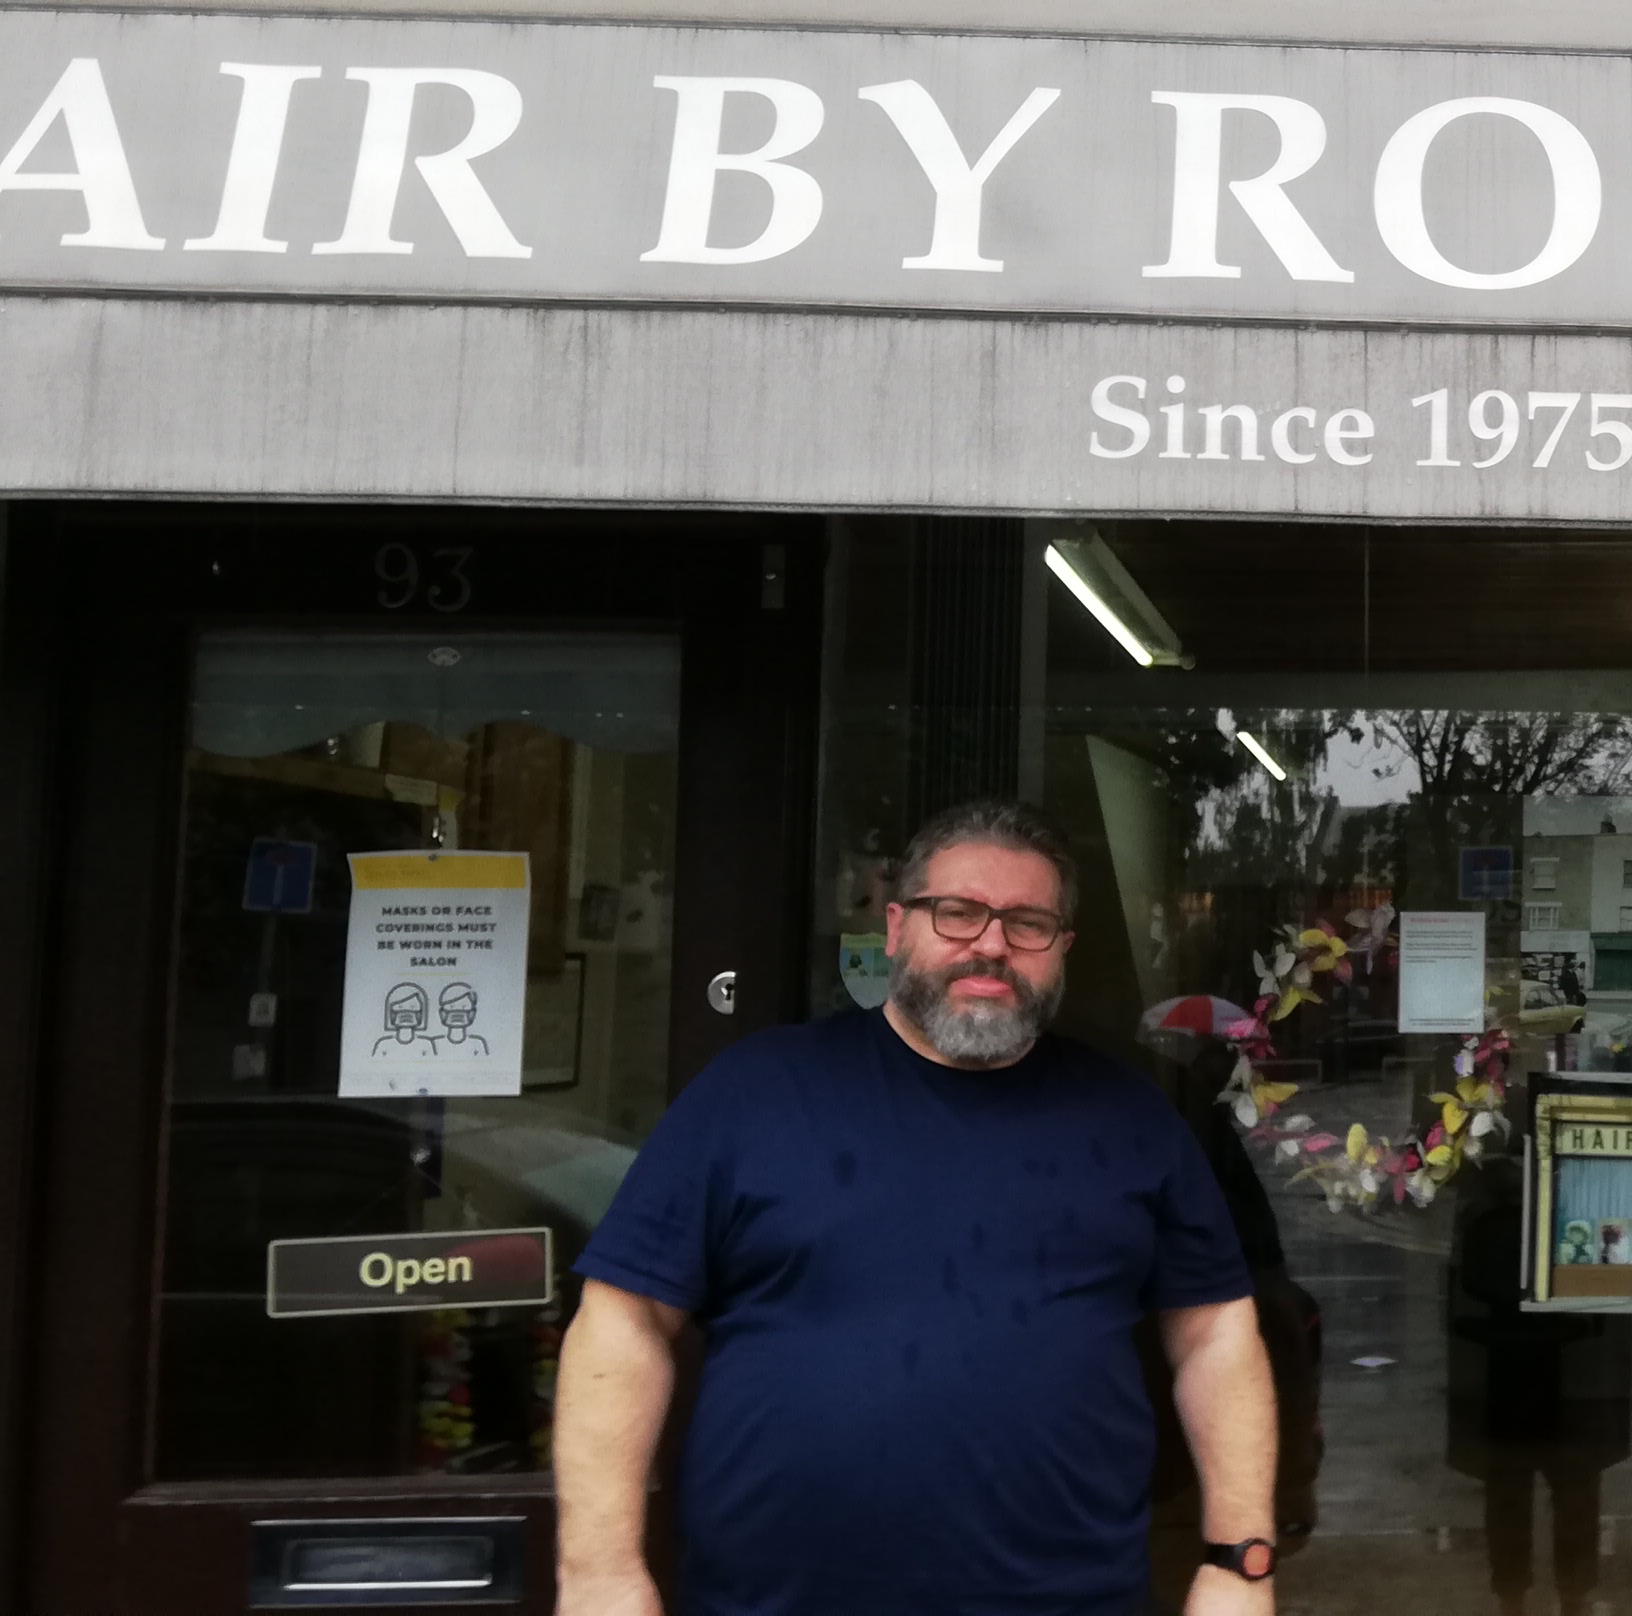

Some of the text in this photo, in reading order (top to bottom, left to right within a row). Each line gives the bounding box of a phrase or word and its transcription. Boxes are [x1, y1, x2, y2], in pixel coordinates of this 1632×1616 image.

[640, 75, 1061, 273] BY
[1089, 375, 1375, 466] Since
[374, 541, 474, 612] 93
[381, 905, 493, 917] MASKS OR FACE
[375, 922, 498, 934] COVERINGS MUST
[376, 939, 494, 951] BE WORN IN THE
[409, 956, 458, 968] SALON
[359, 1251, 473, 1294] Open
